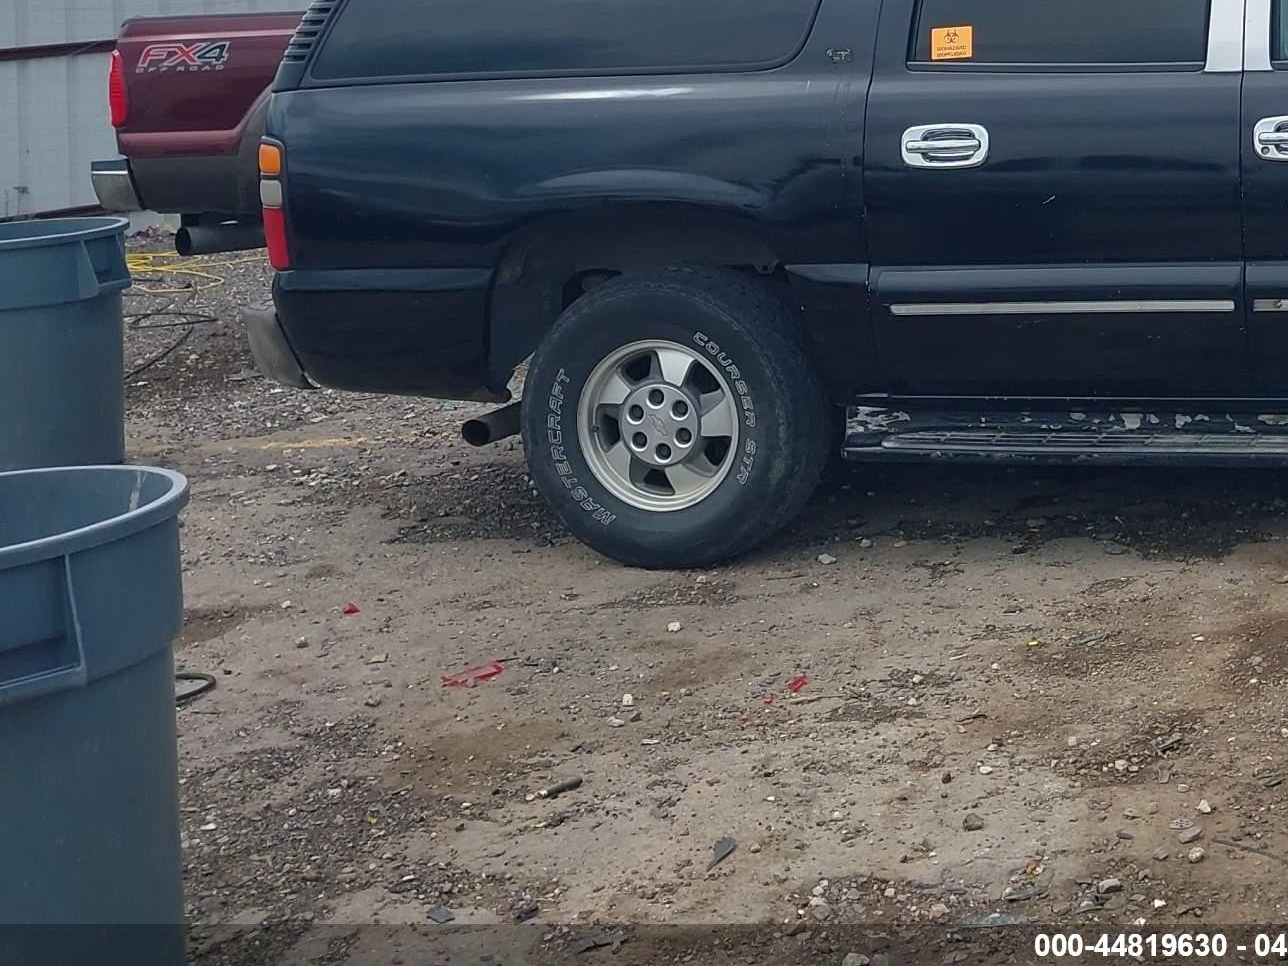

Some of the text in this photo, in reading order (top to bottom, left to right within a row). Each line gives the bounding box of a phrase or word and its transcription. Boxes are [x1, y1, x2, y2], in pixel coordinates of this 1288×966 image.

[136, 64, 225, 74] OFF ROAD
[137, 41, 231, 67] FX4
[546, 368, 617, 525] MASTERCRAFT
[693, 331, 757, 485] COURSER STR
